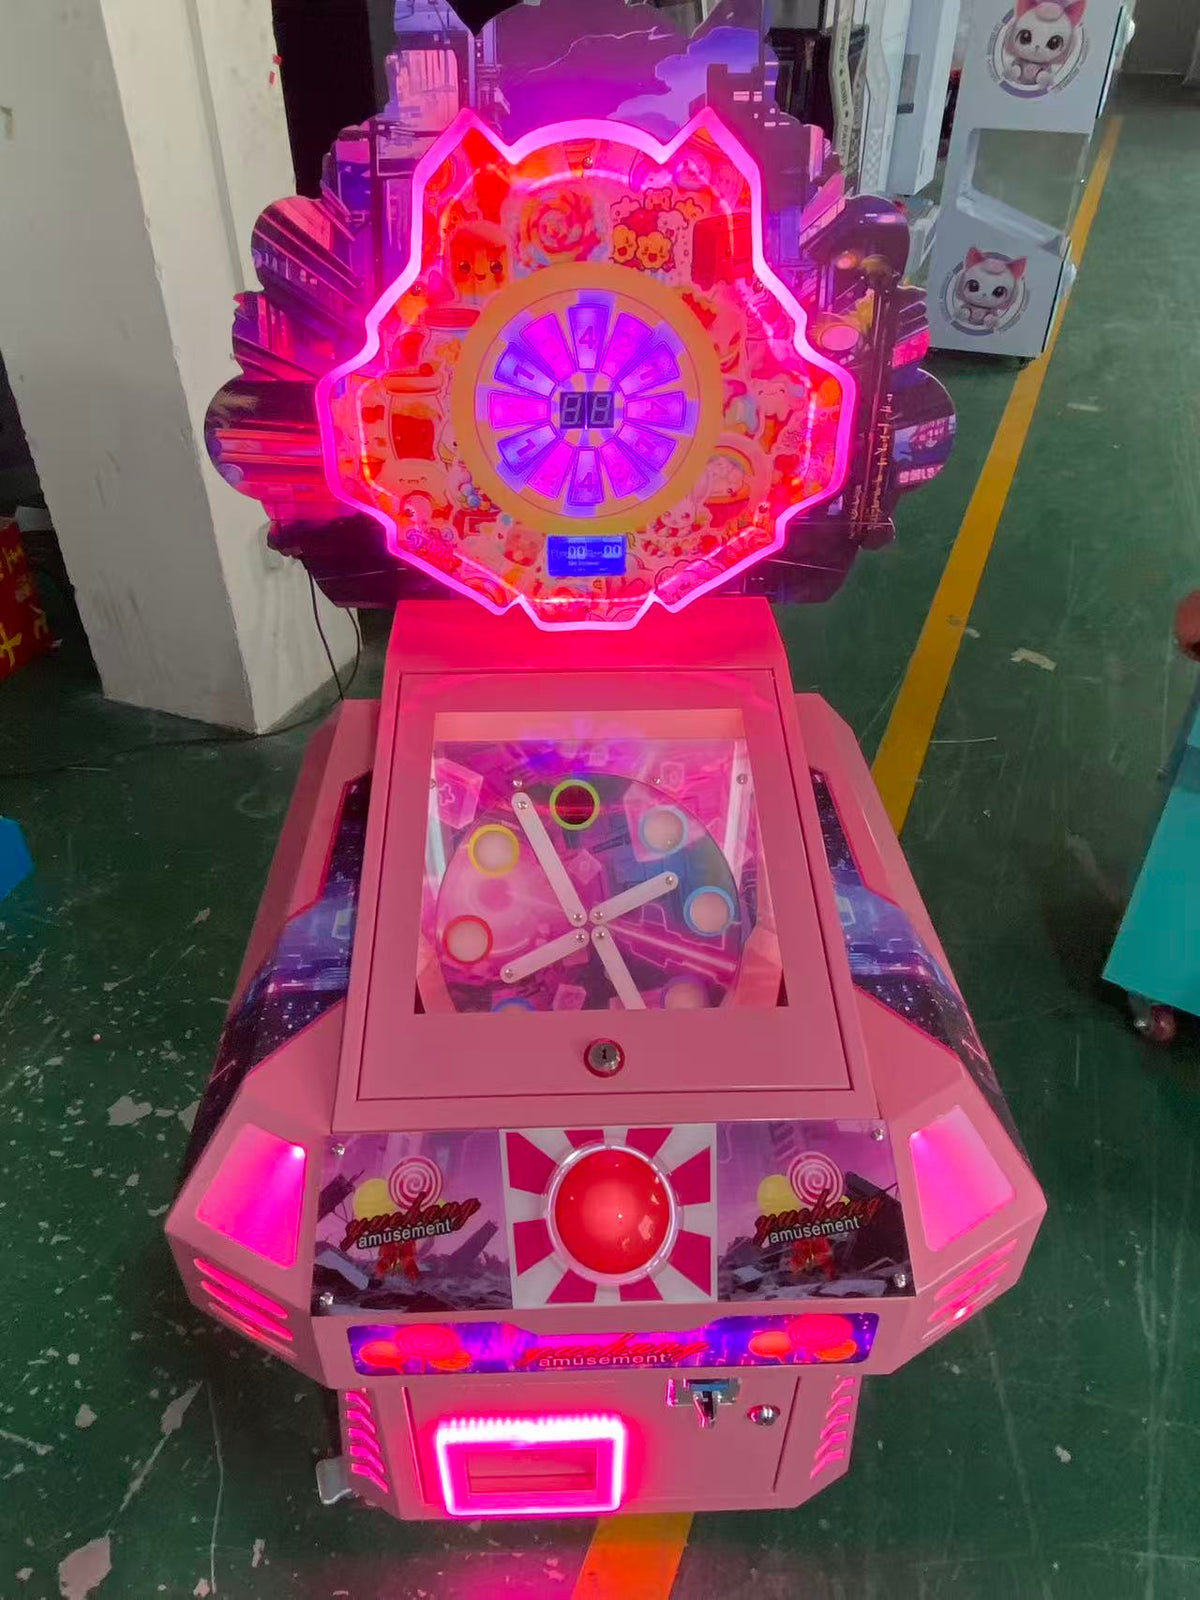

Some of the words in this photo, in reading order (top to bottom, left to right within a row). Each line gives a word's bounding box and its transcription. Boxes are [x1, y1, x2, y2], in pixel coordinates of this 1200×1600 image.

[578, 325, 596, 349] 4
[513, 363, 536, 381] 1
[639, 362, 661, 381] 1
[516, 438, 536, 457] 1
[634, 437, 656, 452] 1
[578, 471, 595, 493] 4
[357, 1220, 452, 1248] amusement
[769, 1216, 860, 1243] amusement
[539, 1353, 669, 1368] amusement
